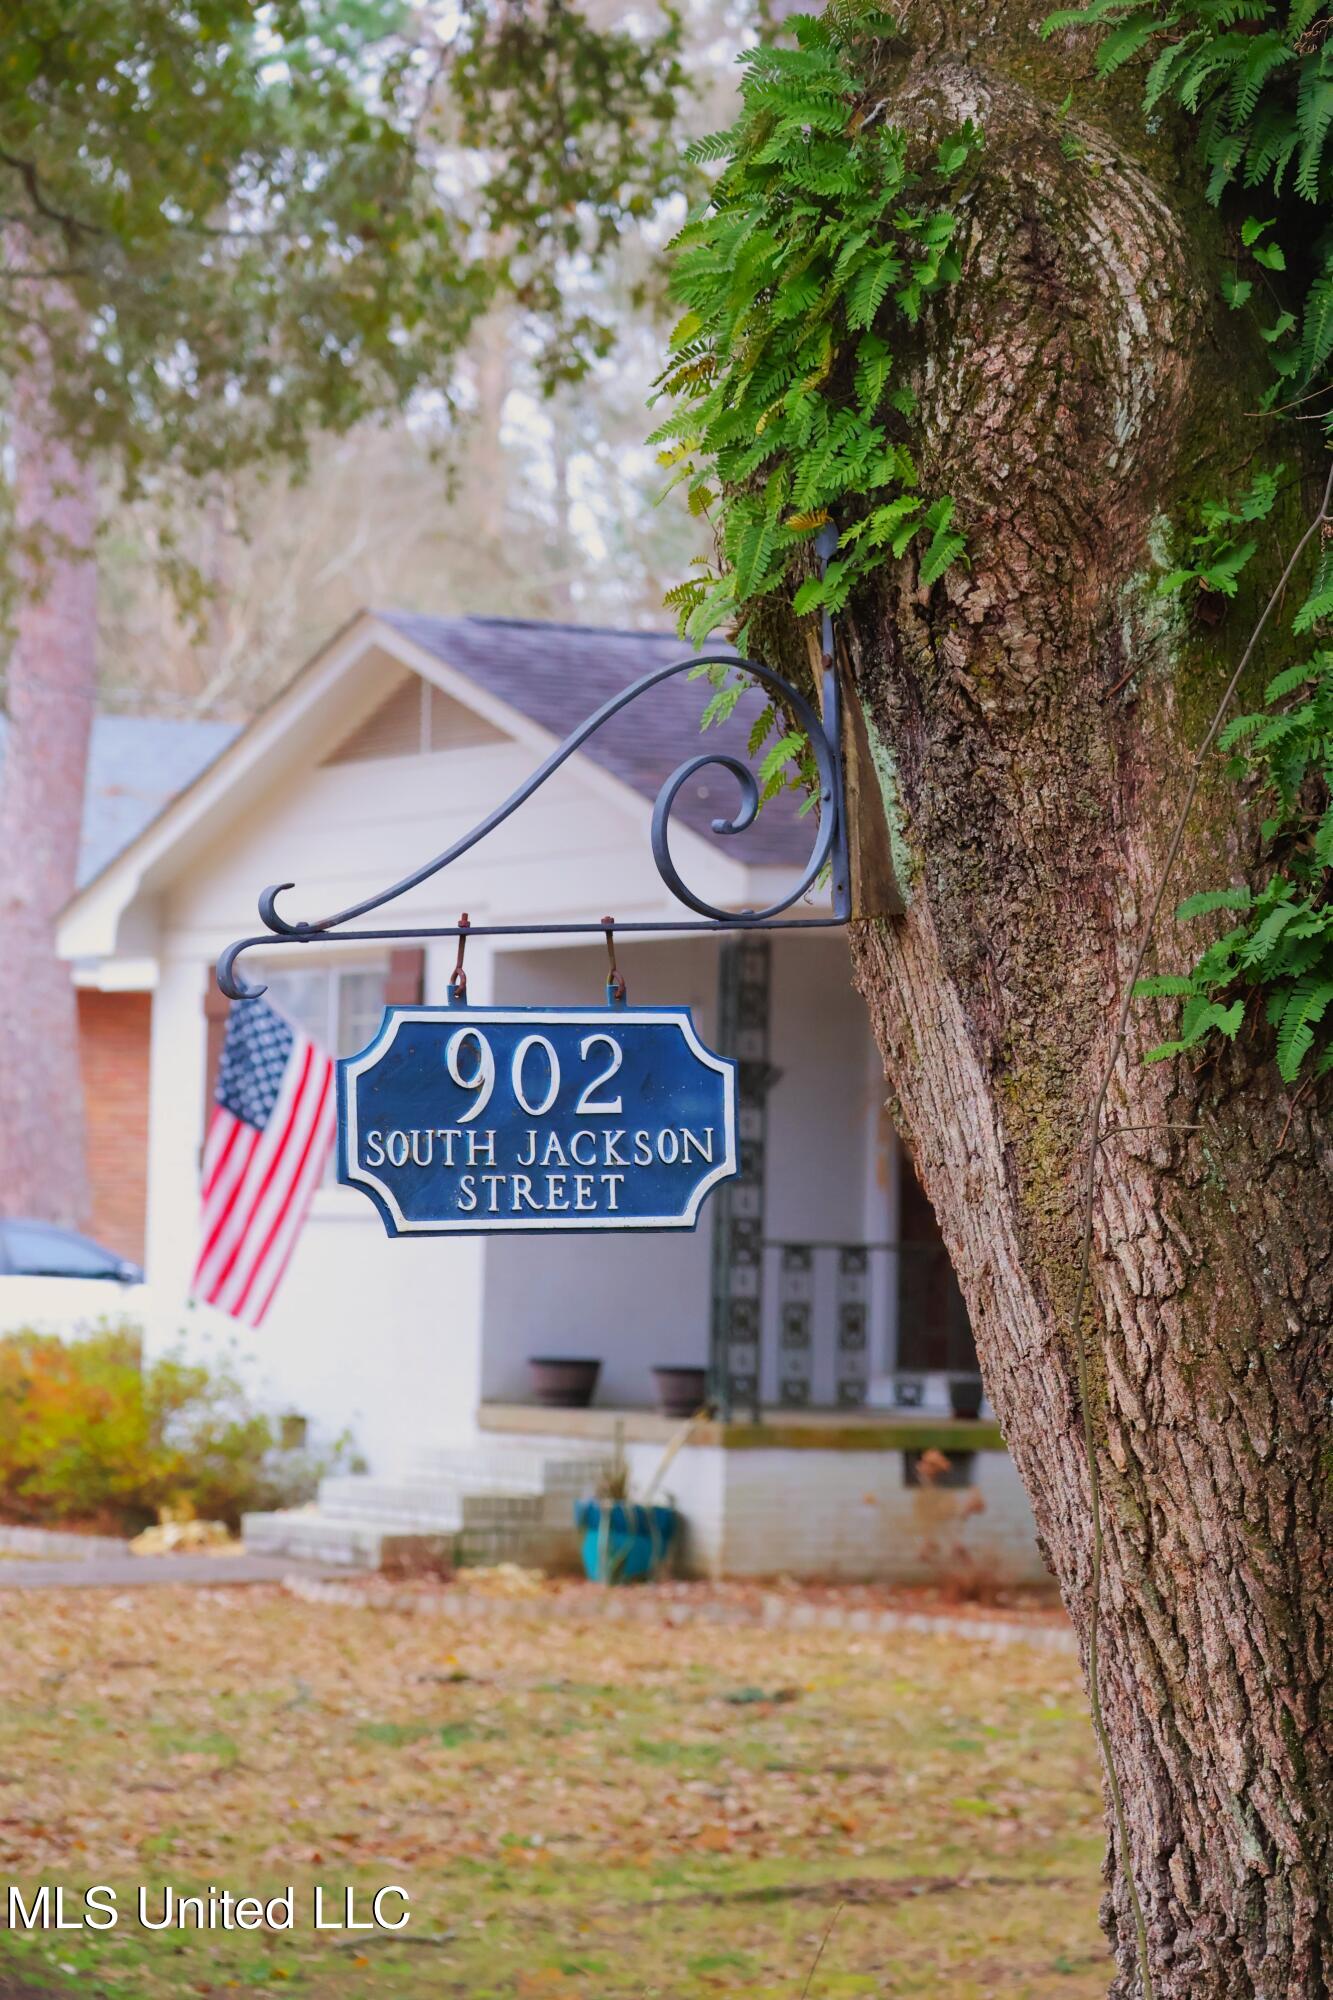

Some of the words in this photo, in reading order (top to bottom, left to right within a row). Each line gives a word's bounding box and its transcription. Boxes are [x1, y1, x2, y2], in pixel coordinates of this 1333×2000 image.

[446, 1026, 623, 1123] 902
[365, 1129, 497, 1168] SOUTH
[516, 1127, 714, 1167] JACKSON
[457, 1174, 625, 1212] STREET
